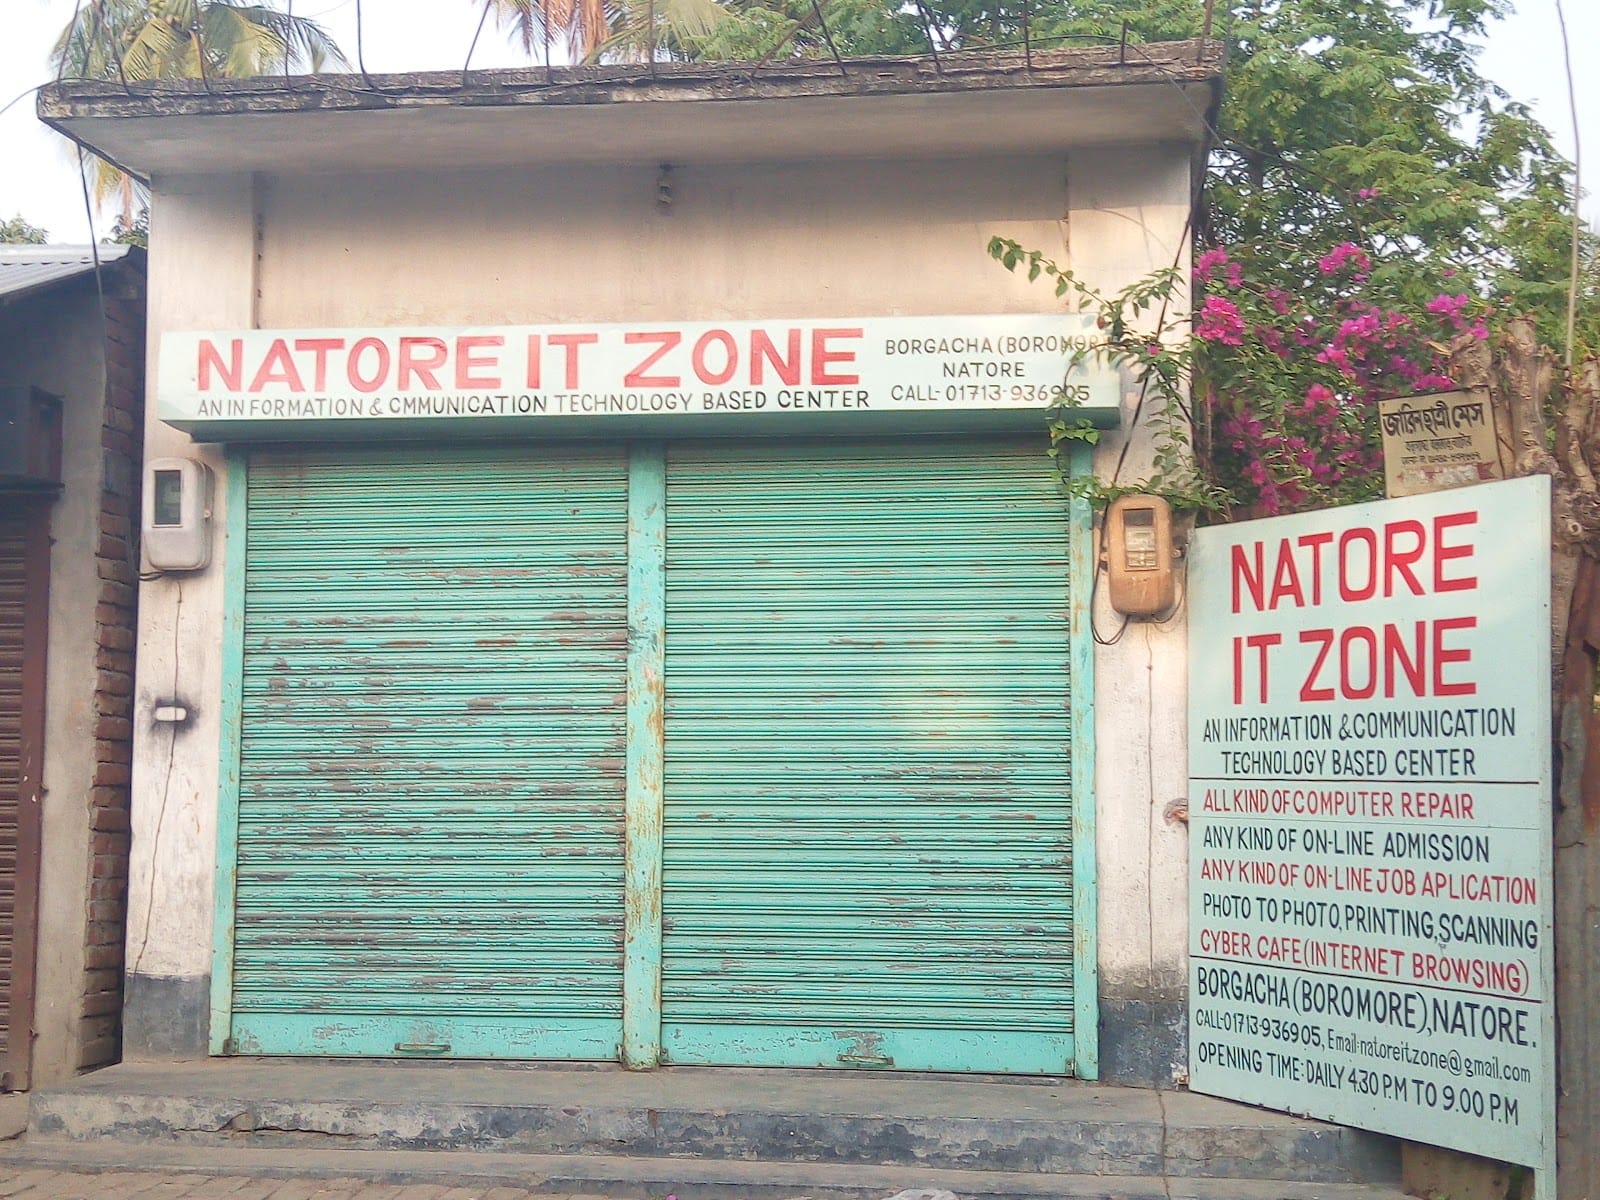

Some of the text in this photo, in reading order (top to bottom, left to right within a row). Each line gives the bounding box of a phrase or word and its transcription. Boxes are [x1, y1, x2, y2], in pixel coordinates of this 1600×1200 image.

[197, 328, 864, 393] NATORE IT ZONE
[942, 362, 1026, 378] NATORE
[197, 399, 223, 416] AN
[368, 397, 384, 416] &
[388, 395, 548, 415] CMMUNICATION
[553, 393, 693, 412] TECHNOLOGY
[702, 390, 767, 410] BASED
[776, 390, 870, 408] CENTER
[1453, 403, 1485, 428] মেস
[1231, 511, 1479, 614] NATORE
[1233, 616, 1478, 705] IT ZONE
[1203, 707, 1516, 743] AN INFORMATION & COMMUNICATION
[1221, 748, 1477, 777] TECHNOLOGY BASED CENTER
[1202, 788, 1475, 820] ALL KIND OF COMPUTER REPAIR
[1203, 825, 1490, 863] ANY KIND OF ON-LINE ADMISSION
[1201, 857, 1537, 905] ANY KIND OF ON-LINE JOB APLICATION
[1203, 893, 1252, 920] PHOTO
[1256, 897, 1278, 923] TO
[1200, 928, 1253, 958] CYBER
[1412, 952, 1530, 997] BROWSING)
[1198, 1042, 1263, 1074] OPENING
[1411, 1078, 1437, 1107] TO
[1442, 1085, 1484, 1118] 9.00
